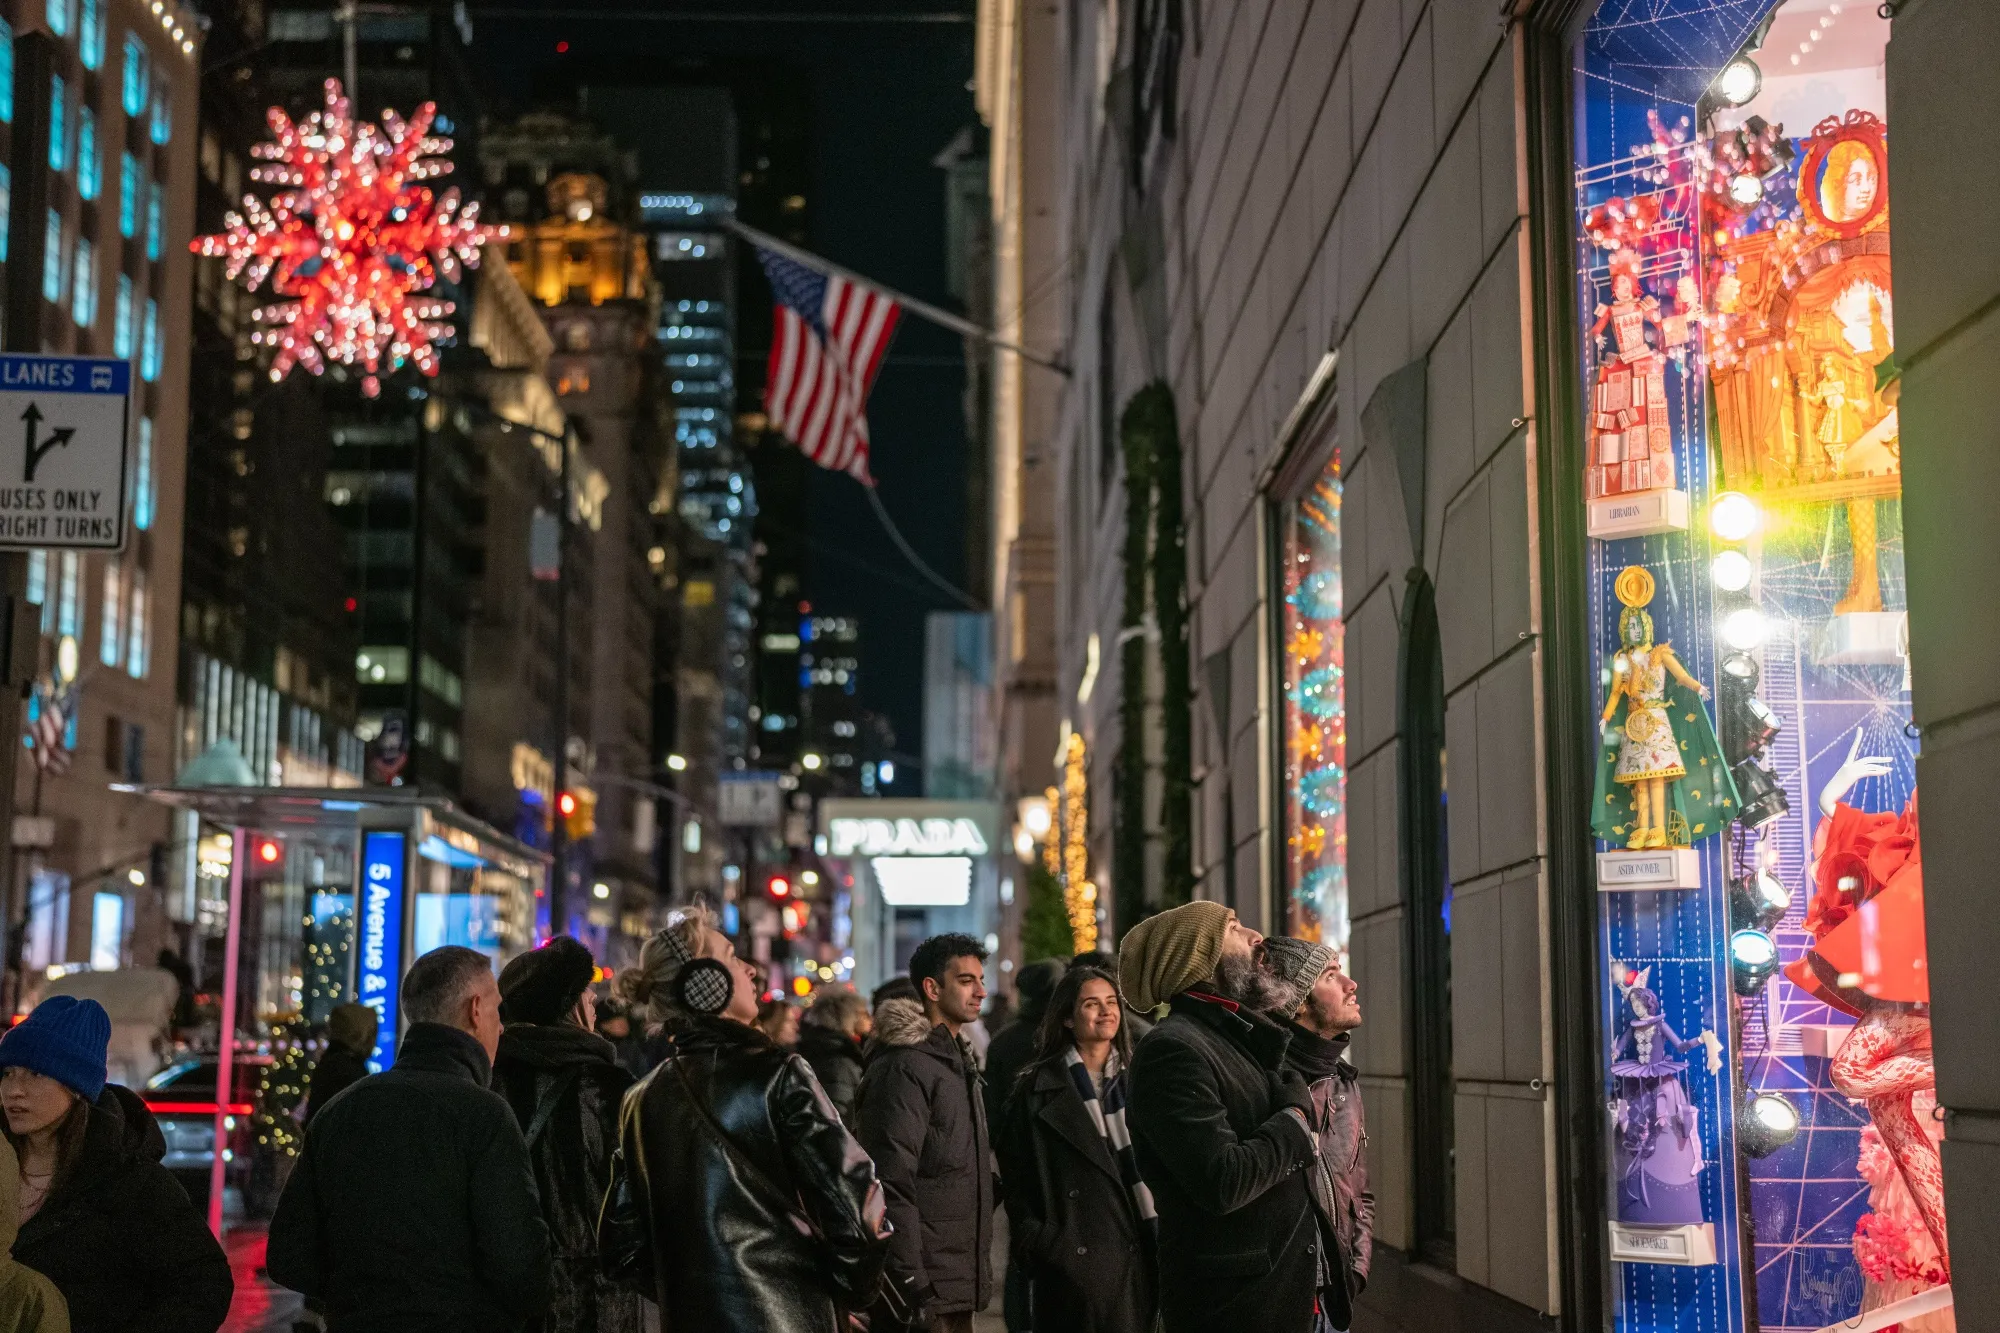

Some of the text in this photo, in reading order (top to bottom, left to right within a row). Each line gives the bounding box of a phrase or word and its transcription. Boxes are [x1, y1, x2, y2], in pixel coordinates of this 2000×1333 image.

[3, 361, 75, 387] LANES
[53, 488, 101, 512] ONLY
[1609, 505, 1640, 519] LIBRARIAN
[55, 516, 113, 540] TURNS
[830, 818, 988, 855] PRADA
[368, 862, 391, 881] 5
[1617, 862, 1660, 876] ASTRONOMER
[364, 882, 391, 971] Avenue
[363, 973, 387, 993] &
[1629, 1236, 1669, 1250] SHOEMAKER
